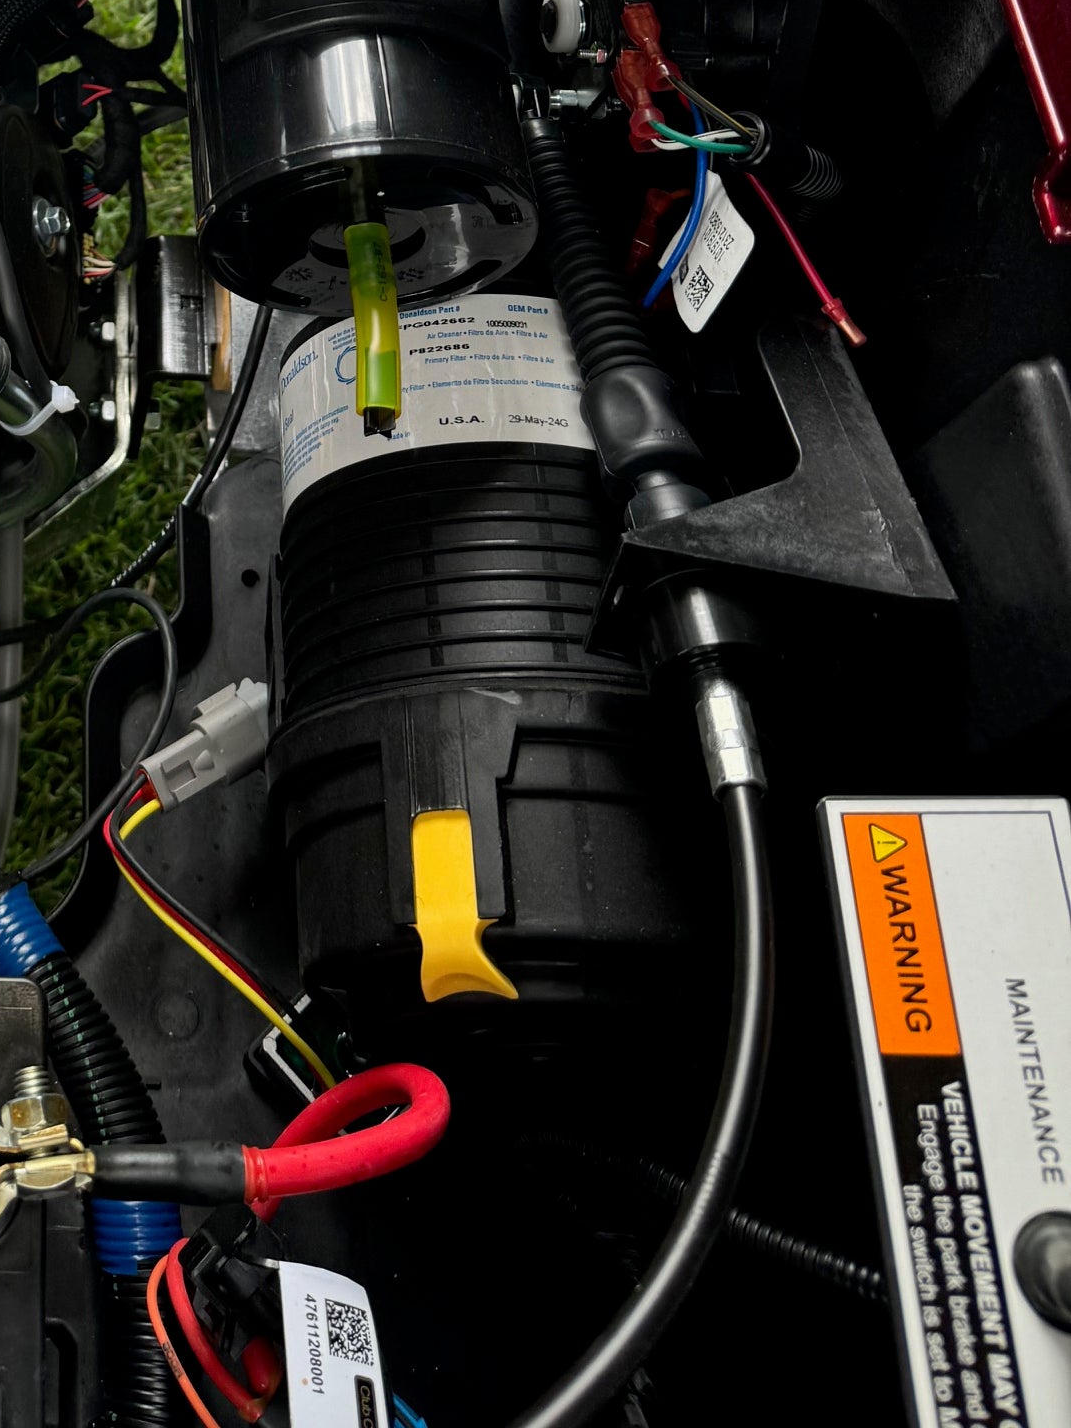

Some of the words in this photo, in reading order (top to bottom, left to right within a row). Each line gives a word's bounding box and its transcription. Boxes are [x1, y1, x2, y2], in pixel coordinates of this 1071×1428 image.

[399, 309, 437, 319] Donaldson
[438, 306, 454, 314] Part
[399, 317, 475, 330] PG042662
[507, 304, 526, 313] OEM
[527, 306, 542, 314] Part
[409, 344, 470, 355] P822686
[427, 332, 436, 340] Air
[437, 331, 462, 339] Cleaner
[425, 356, 449, 364] Primary
[450, 354, 466, 362] Filter
[474, 353, 490, 361] Filtro
[409, 384, 425, 392] Filter
[439, 415, 485, 425] U.S.A.
[508, 414, 569, 427] 29-May-24G
[881, 864, 933, 1034] WARNING
[1005, 978, 1066, 1186] MAINTENANCE
[917, 1104, 947, 1192] Engage
[903, 1184, 924, 1221] the
[932, 1196, 955, 1234] the
[909, 1226, 940, 1302] switch
[934, 1237, 967, 1292] park
[941, 1081, 979, 1192] VEHICLE
[960, 1194, 1007, 1350] MOVEMENT
[987, 1353, 1021, 1417] MAY
[922, 1305, 943, 1328] is
[948, 1295, 978, 1366] brake
[304, 1293, 325, 1396] 47611208001
[927, 1331, 951, 1372] set
[361, 1386, 371, 1416] Club
[933, 1376, 955, 1402] to
[961, 1370, 991, 1419] and
